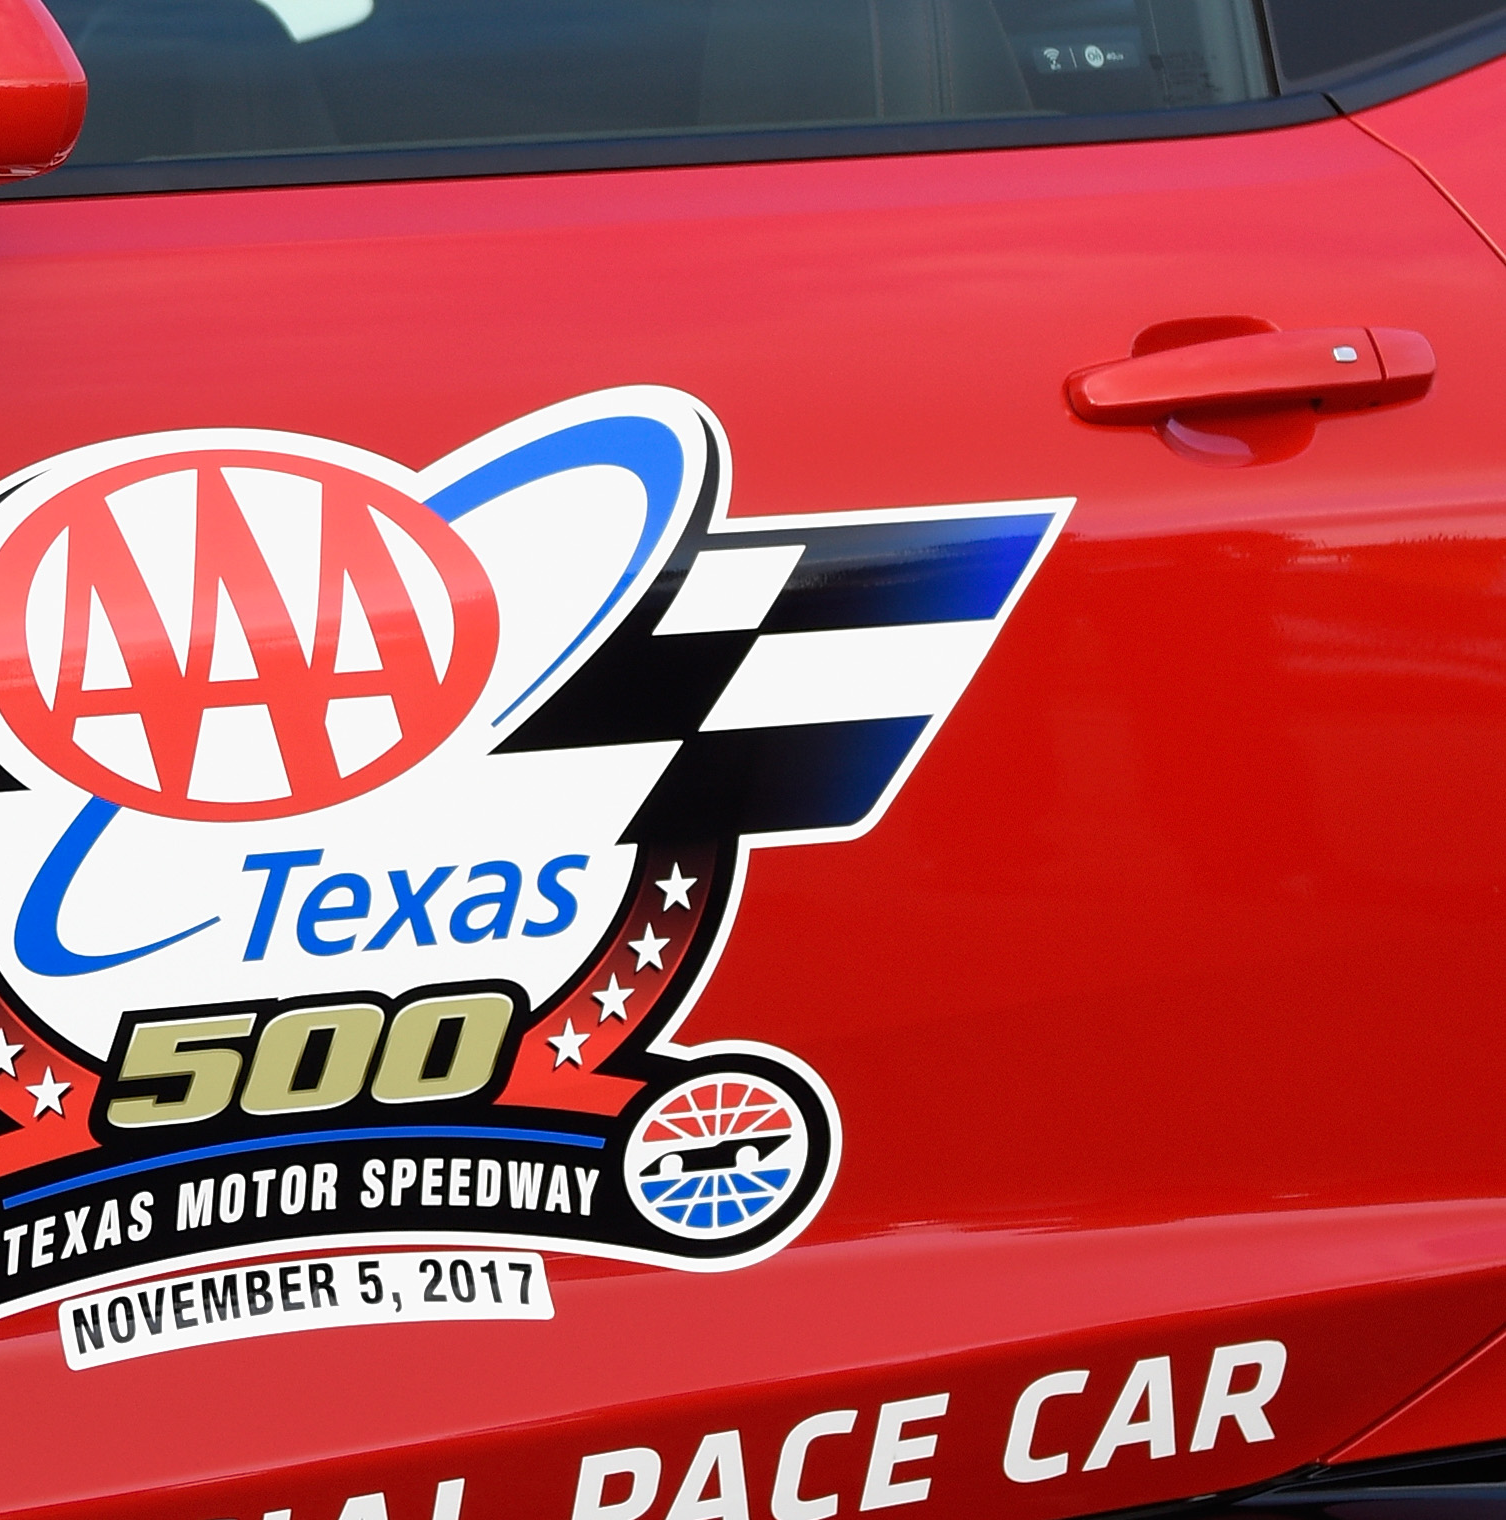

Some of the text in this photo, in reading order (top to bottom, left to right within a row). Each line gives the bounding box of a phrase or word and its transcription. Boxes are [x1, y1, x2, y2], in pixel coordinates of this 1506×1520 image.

[29, 458, 464, 815] AAA
[242, 848, 590, 962] Texas
[106, 992, 514, 1128] 500
[2, 1158, 600, 1276] TEXAS MOTOR SPEEDWAY
[72, 1259, 534, 1355] NOVEMBER 5, 2017
[1002, 1339, 1288, 1484] CAR
